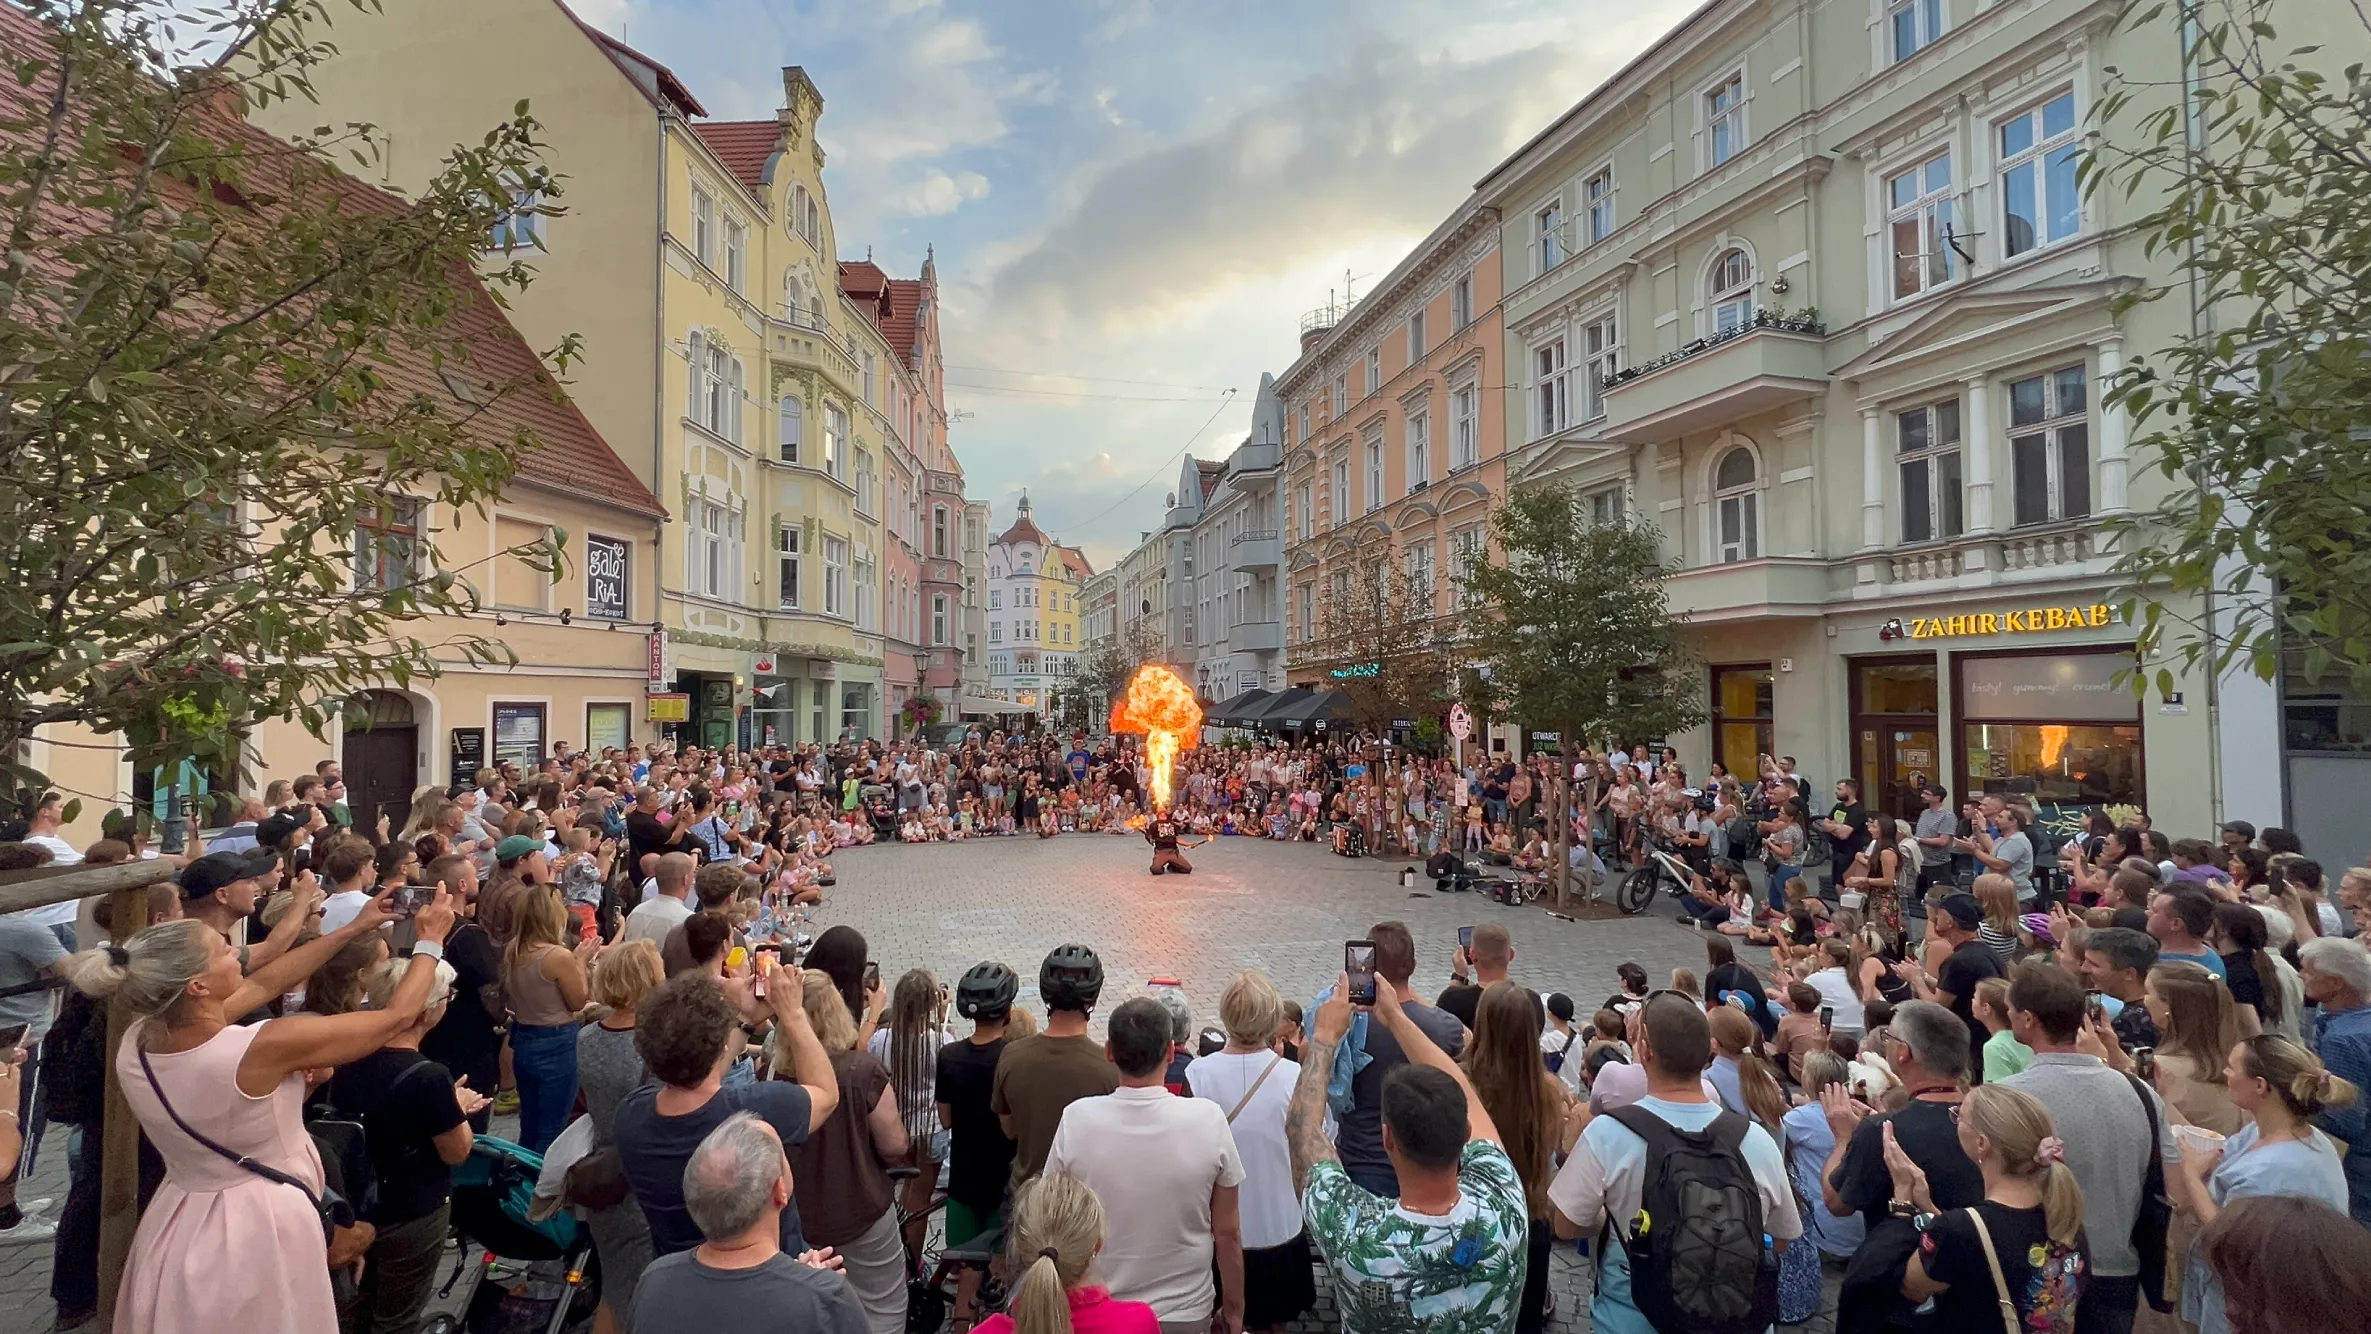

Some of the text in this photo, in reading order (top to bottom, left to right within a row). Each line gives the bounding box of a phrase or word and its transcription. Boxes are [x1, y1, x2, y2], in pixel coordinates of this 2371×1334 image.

[1911, 604, 2111, 639] ZAHIR KEBAB
[652, 634, 660, 677] KANTOR
